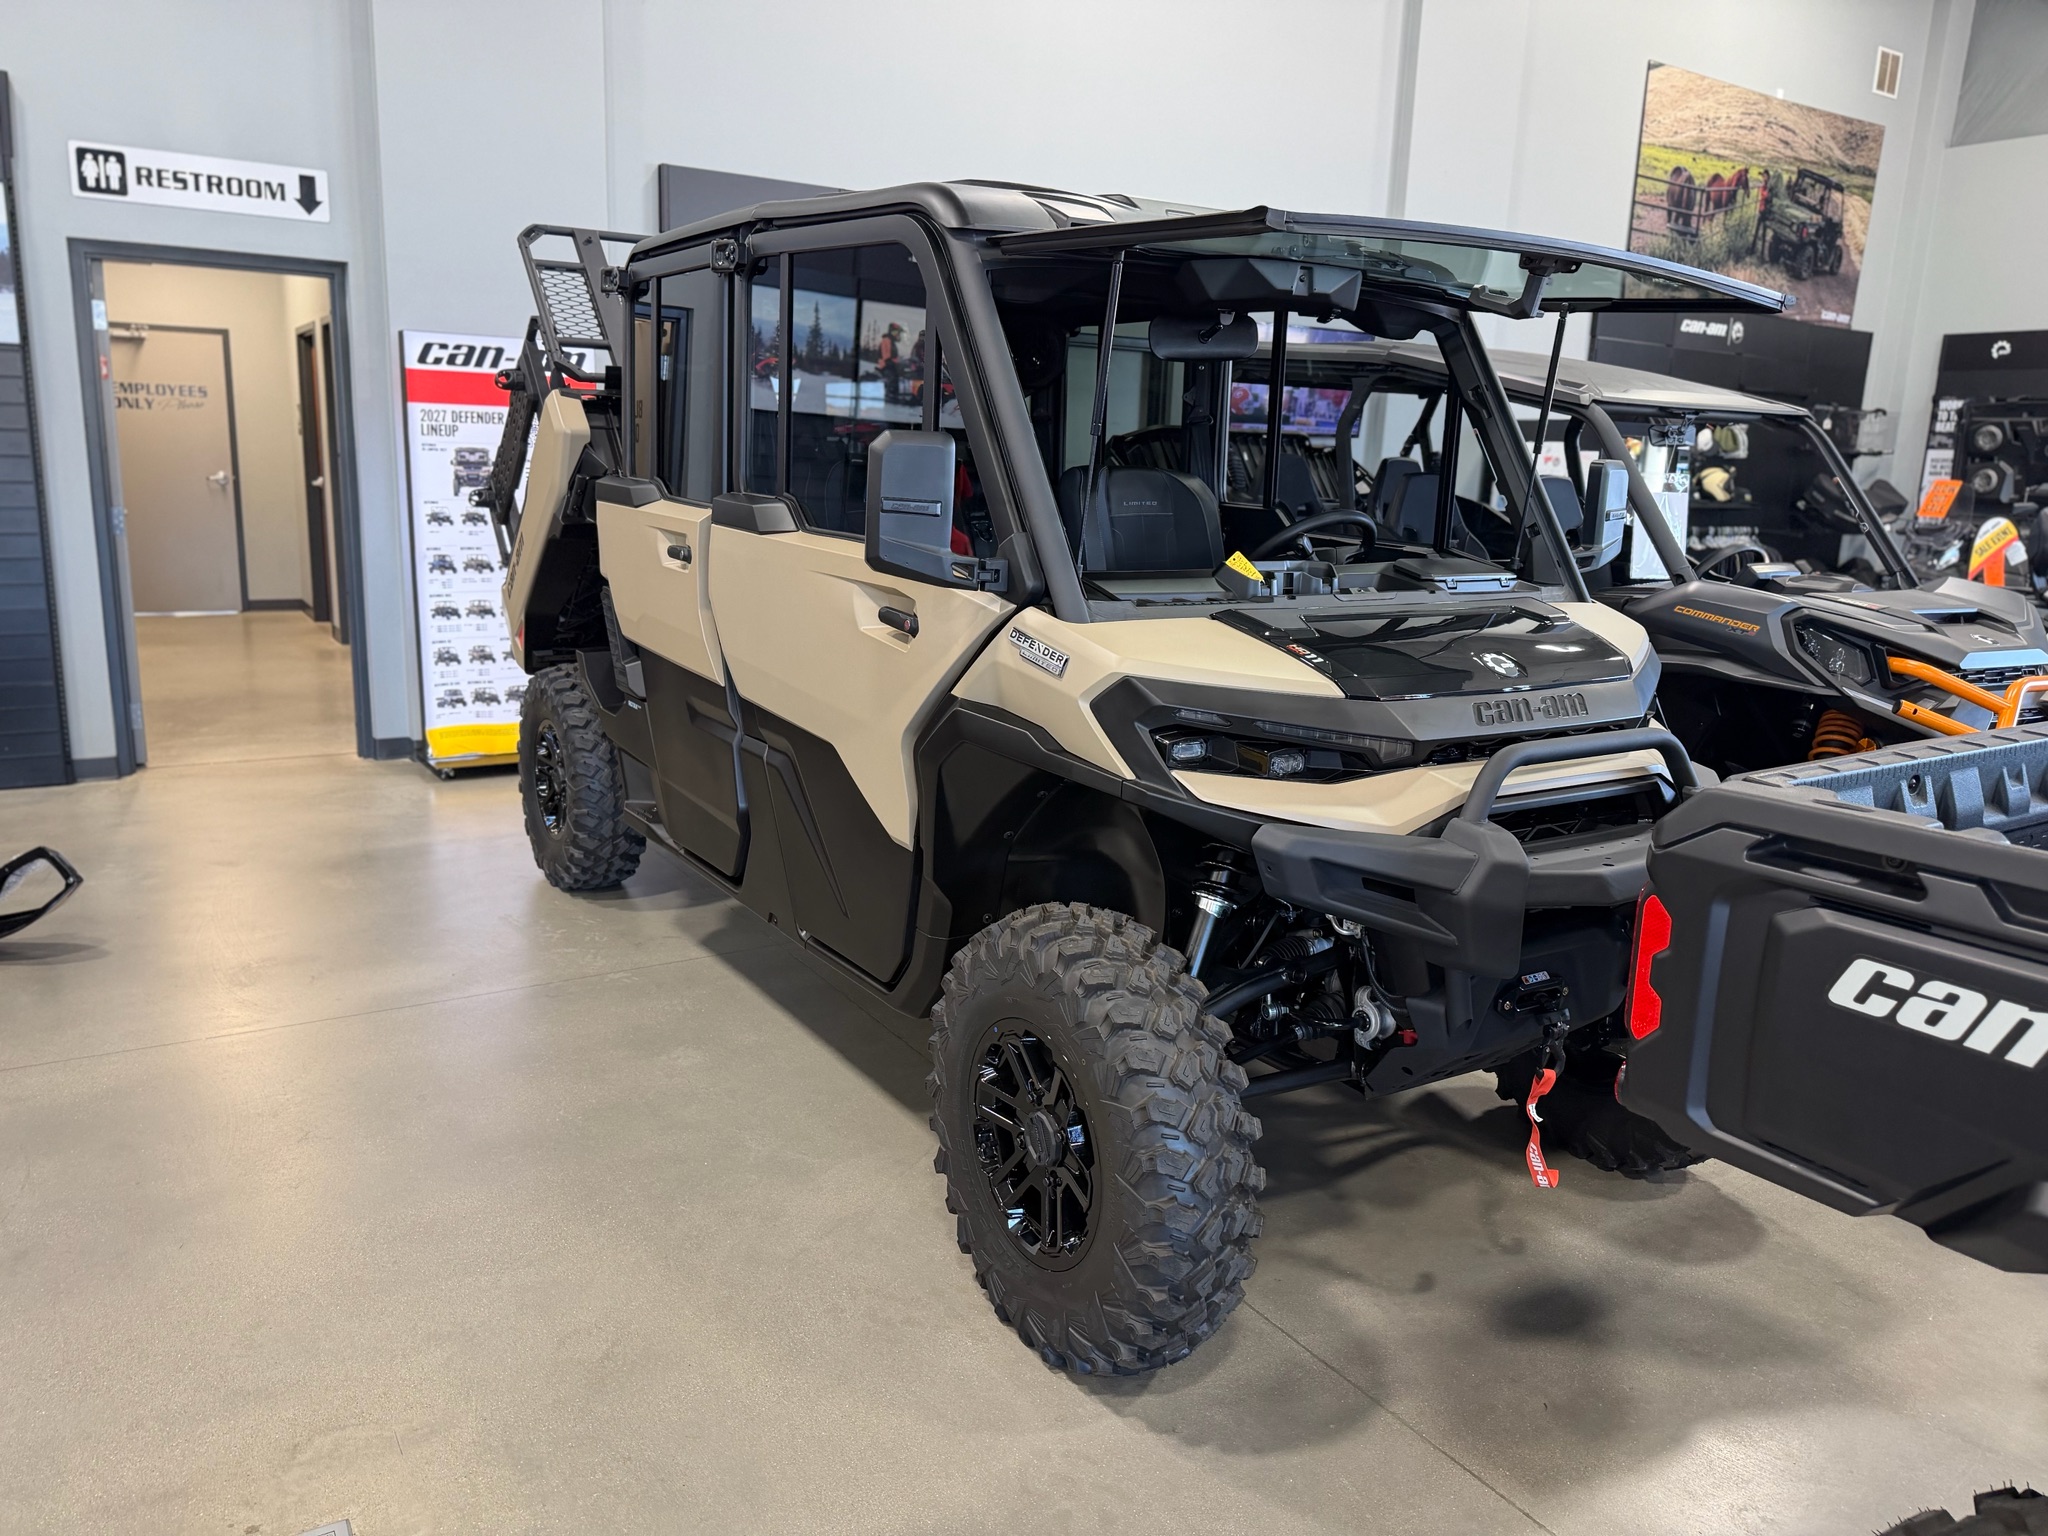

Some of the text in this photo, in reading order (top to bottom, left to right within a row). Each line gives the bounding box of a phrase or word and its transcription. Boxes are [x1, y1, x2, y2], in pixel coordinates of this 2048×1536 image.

[135, 166, 286, 202] RESTROOM
[1680, 319, 1728, 337] can-am
[417, 342, 586, 371] can-m
[421, 409, 504, 425] 2027 DEFENDER
[421, 424, 459, 438] LINEUP
[1975, 542, 1993, 557] SALE
[1992, 527, 2012, 546] EVENT
[1674, 605, 1760, 632] COMMANDER
[1010, 630, 1064, 665] DEFENDER
[1471, 693, 1589, 727] can-am
[1828, 958, 2048, 1068] can
